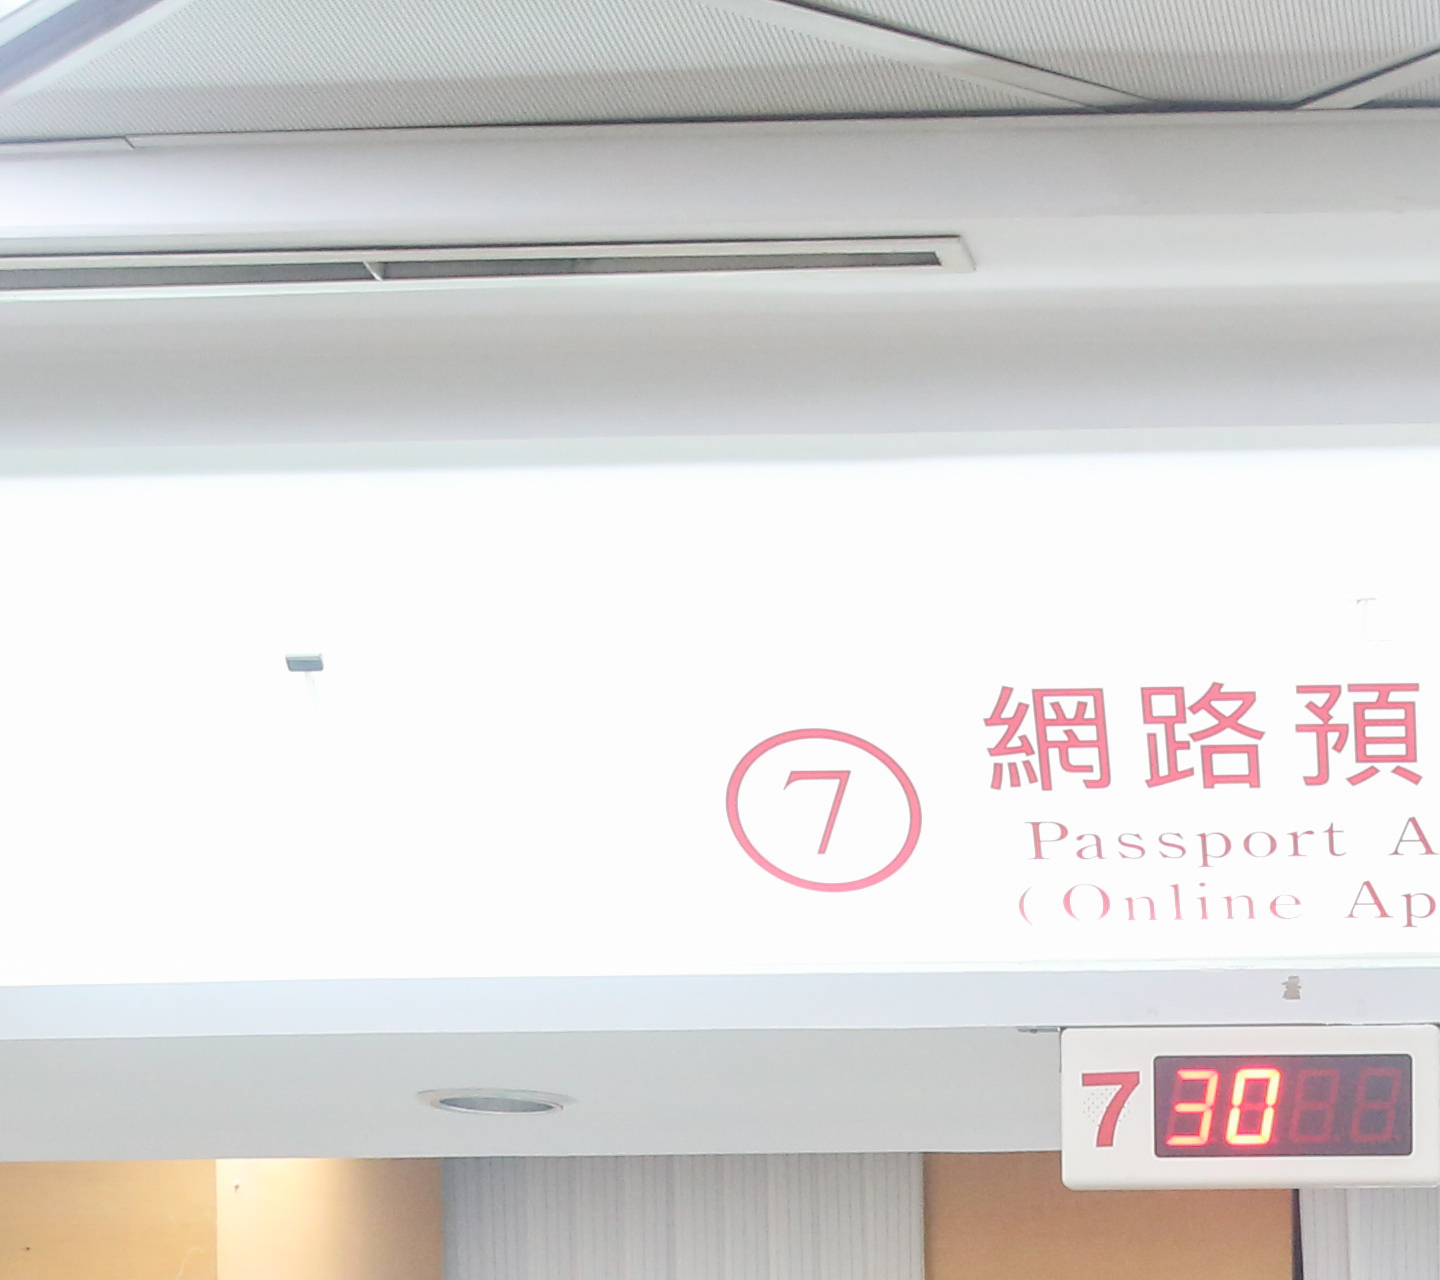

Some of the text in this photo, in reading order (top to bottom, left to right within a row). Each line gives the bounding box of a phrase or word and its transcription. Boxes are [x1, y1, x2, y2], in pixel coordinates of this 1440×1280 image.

[780, 768, 852, 856] 7
[1024, 816, 1350, 870] Passport
[1081, 1072, 1140, 1148] 7
[1166, 1067, 1282, 1147] 30
